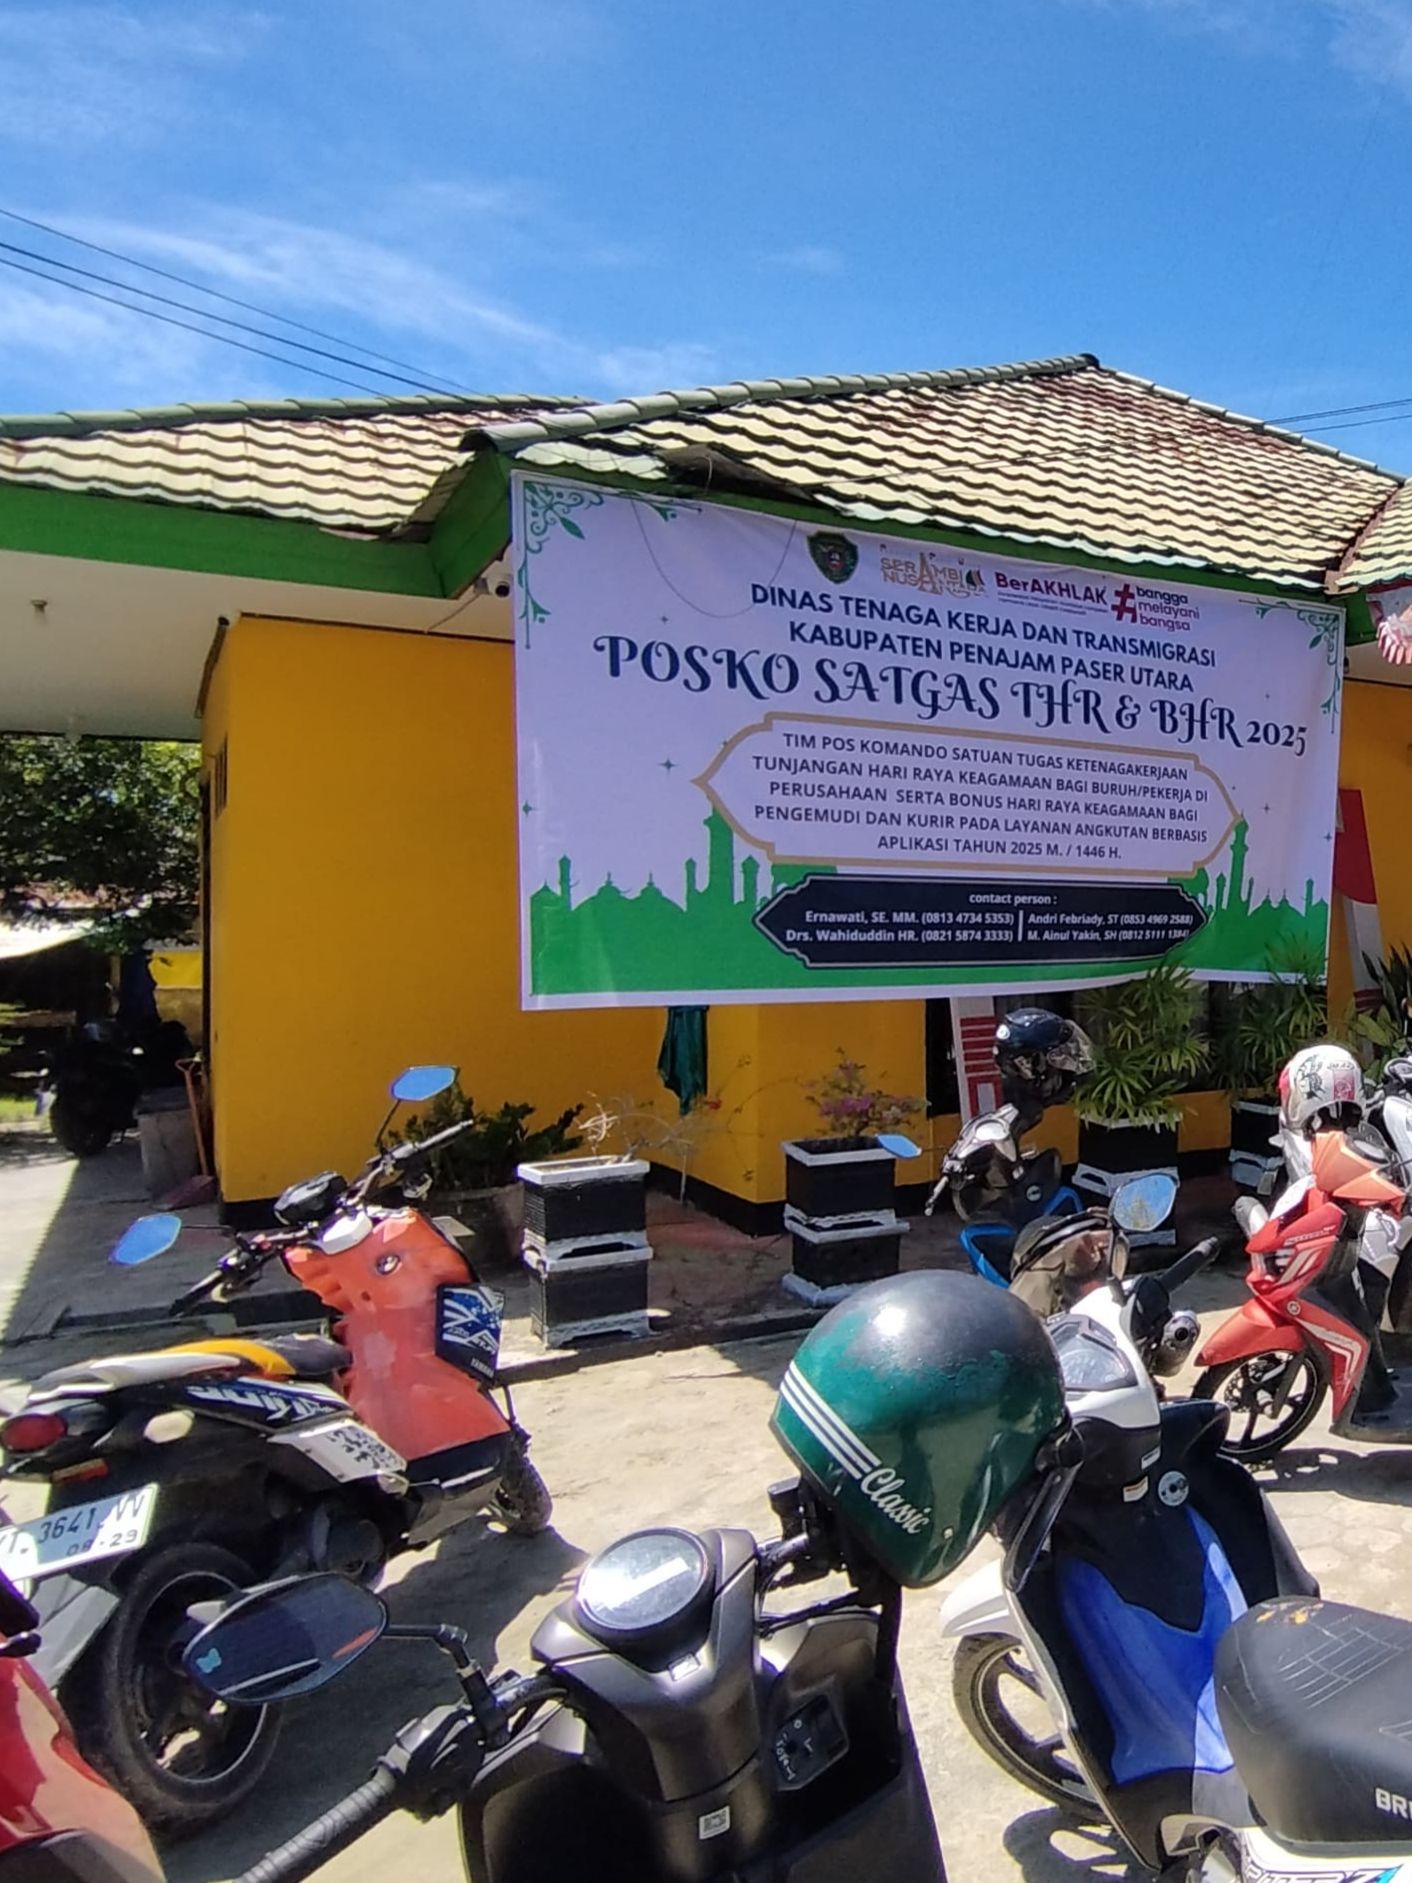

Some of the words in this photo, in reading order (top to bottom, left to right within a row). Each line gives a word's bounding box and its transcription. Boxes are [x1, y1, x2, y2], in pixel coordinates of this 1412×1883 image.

[994, 572, 1108, 605] BerAKHLAK
[1135, 586, 1189, 606] bangga
[751, 583, 834, 614] DINAS
[839, 595, 942, 628] TENAGA
[946, 610, 1017, 639] KERJA
[1022, 621, 1067, 645] DAN
[1072, 629, 1217, 667] TRANSMIGRASI
[1137, 600, 1200, 619] melayani
[1139, 613, 1191, 632] bangsa
[789, 621, 942, 660] KABUPATEN
[949, 641, 1055, 674] PENAJAM
[1060, 656, 1125, 683] PASER
[1130, 666, 1194, 692] UTARA
[593, 635, 801, 700] POSKO
[813, 657, 1002, 720] SATGAS
[1009, 679, 1112, 734] THR
[1114, 694, 1142, 730] &
[1149, 697, 1244, 748] BHR
[1246, 720, 1307, 757] 2025
[783, 733, 816, 749] TIM
[822, 736, 855, 752] POS
[860, 740, 948, 760] KOMANDO
[952, 746, 1013, 765] SATUAN
[1017, 753, 1063, 769] TUGAS
[1067, 757, 1188, 782] KETENAGAKERJAAN
[752, 755, 863, 776] TUNJANGAN
[868, 764, 907, 779] HARI
[913, 767, 954, 783] RAYA
[959, 771, 1052, 790] KEAGAMAAN
[1056, 777, 1088, 793] BAGI
[1091, 783, 1192, 803] BURUH/PEKERJA
[1195, 790, 1208, 802] DI
[769, 781, 887, 801] PERUSAHAAN
[896, 789, 945, 805] SERTA
[949, 792, 1003, 809] BONUS
[1007, 796, 1041, 811] HARI
[1045, 799, 1081, 814] RAYA
[1084, 803, 1166, 819] KEAGAMAAN
[1169, 808, 1198, 822] BAGI
[754, 805, 860, 824] PENGEMUDI
[865, 811, 902, 826] DAN
[906, 813, 955, 829] KURIR
[959, 816, 1000, 831] PADA
[1004, 819, 1072, 835] LAYANAN
[1074, 823, 1148, 839] ANGKUTAN
[1152, 828, 1208, 843] BERBASIS
[877, 835, 949, 851] APLIKASI
[953, 838, 1007, 854] TAHUN
[1010, 841, 1043, 856] 2025
[1046, 843, 1063, 856] M.
[1076, 845, 1106, 858] 1446
[1109, 846, 1122, 859] H.
[969, 893, 1012, 905] contact
[1013, 894, 1051, 907] person
[805, 910, 868, 925] Ernawati,
[871, 911, 889, 923] SE.
[892, 912, 919, 924] MM.
[921, 911, 953, 926] (0813
[955, 912, 982, 924] 4734
[984, 912, 1015, 926] 5353)
[1027, 912, 1058, 924] Andri
[1059, 913, 1106, 928] Febriady,
[1107, 913, 1119, 924] ST
[786, 929, 813, 942] Drs.
[816, 928, 895, 942] Wahiduddin
[898, 930, 919, 942] HR.
[921, 929, 952, 943] (0821
[954, 930, 982, 942] 5874
[983, 930, 1014, 943] 3333)
[1042, 929, 1070, 941] Ainul
[860, 1467, 932, 1534] Classic
[38, 1506, 98, 1544] 3641
